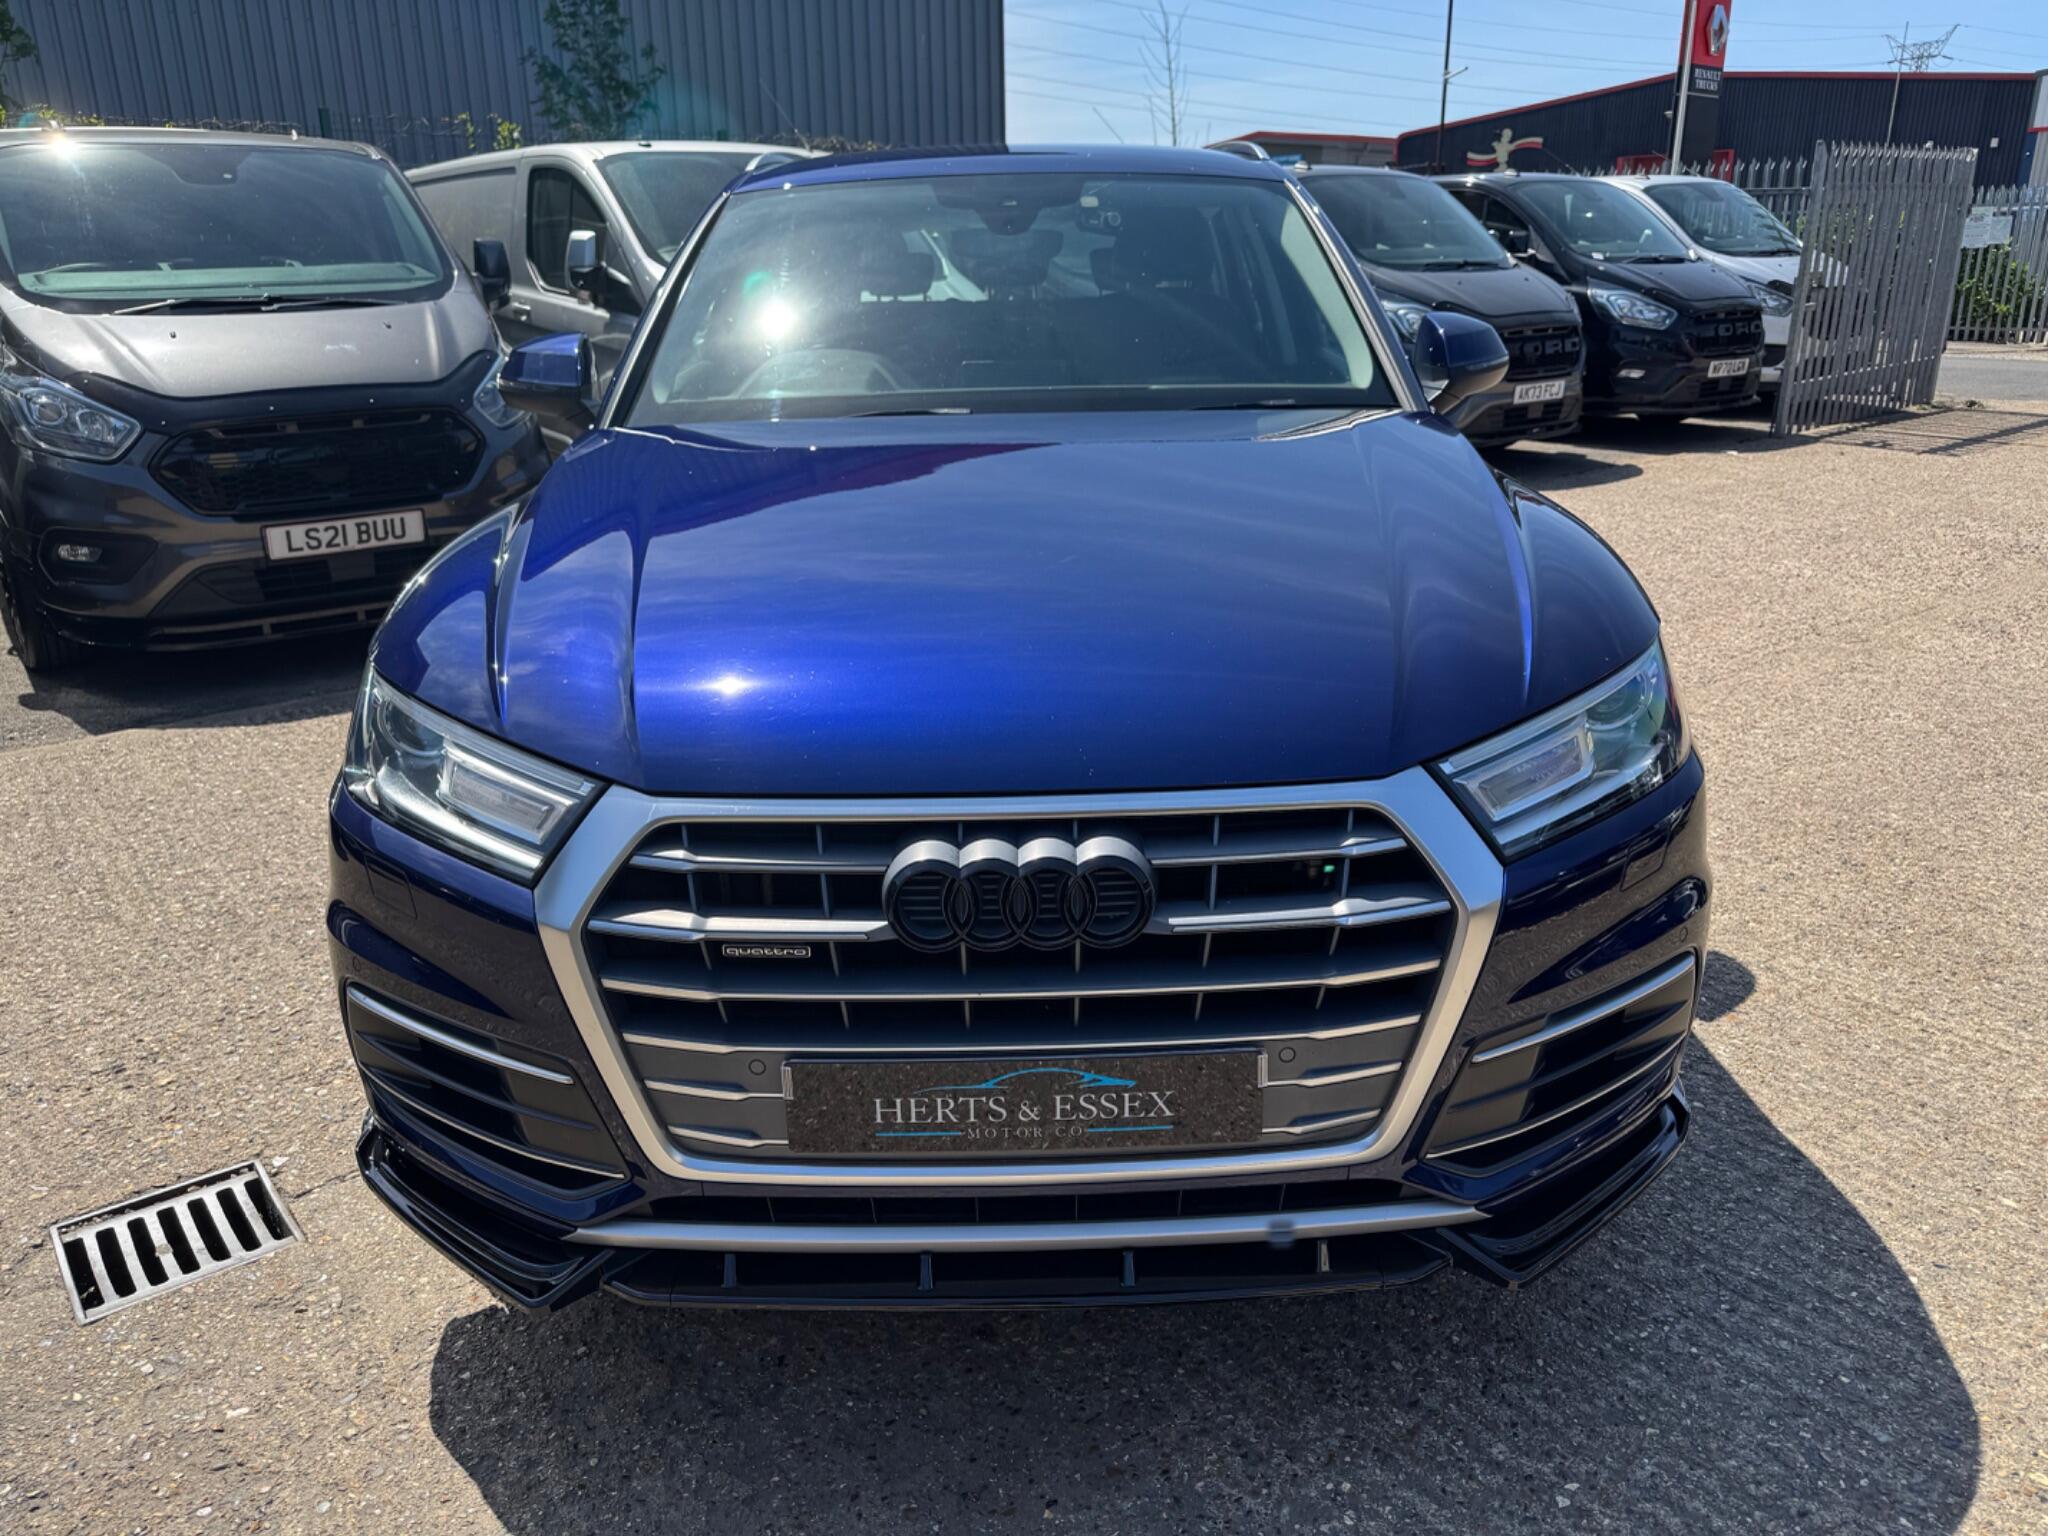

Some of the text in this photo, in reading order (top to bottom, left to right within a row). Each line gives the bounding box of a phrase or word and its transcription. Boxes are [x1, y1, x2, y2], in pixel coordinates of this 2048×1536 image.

[285, 517, 406, 553] LS21 BUU
[726, 947, 806, 957] quattro
[873, 1091, 1176, 1124] HERTS & ESSEX
[966, 1126, 1084, 1140] MOTOR CO
